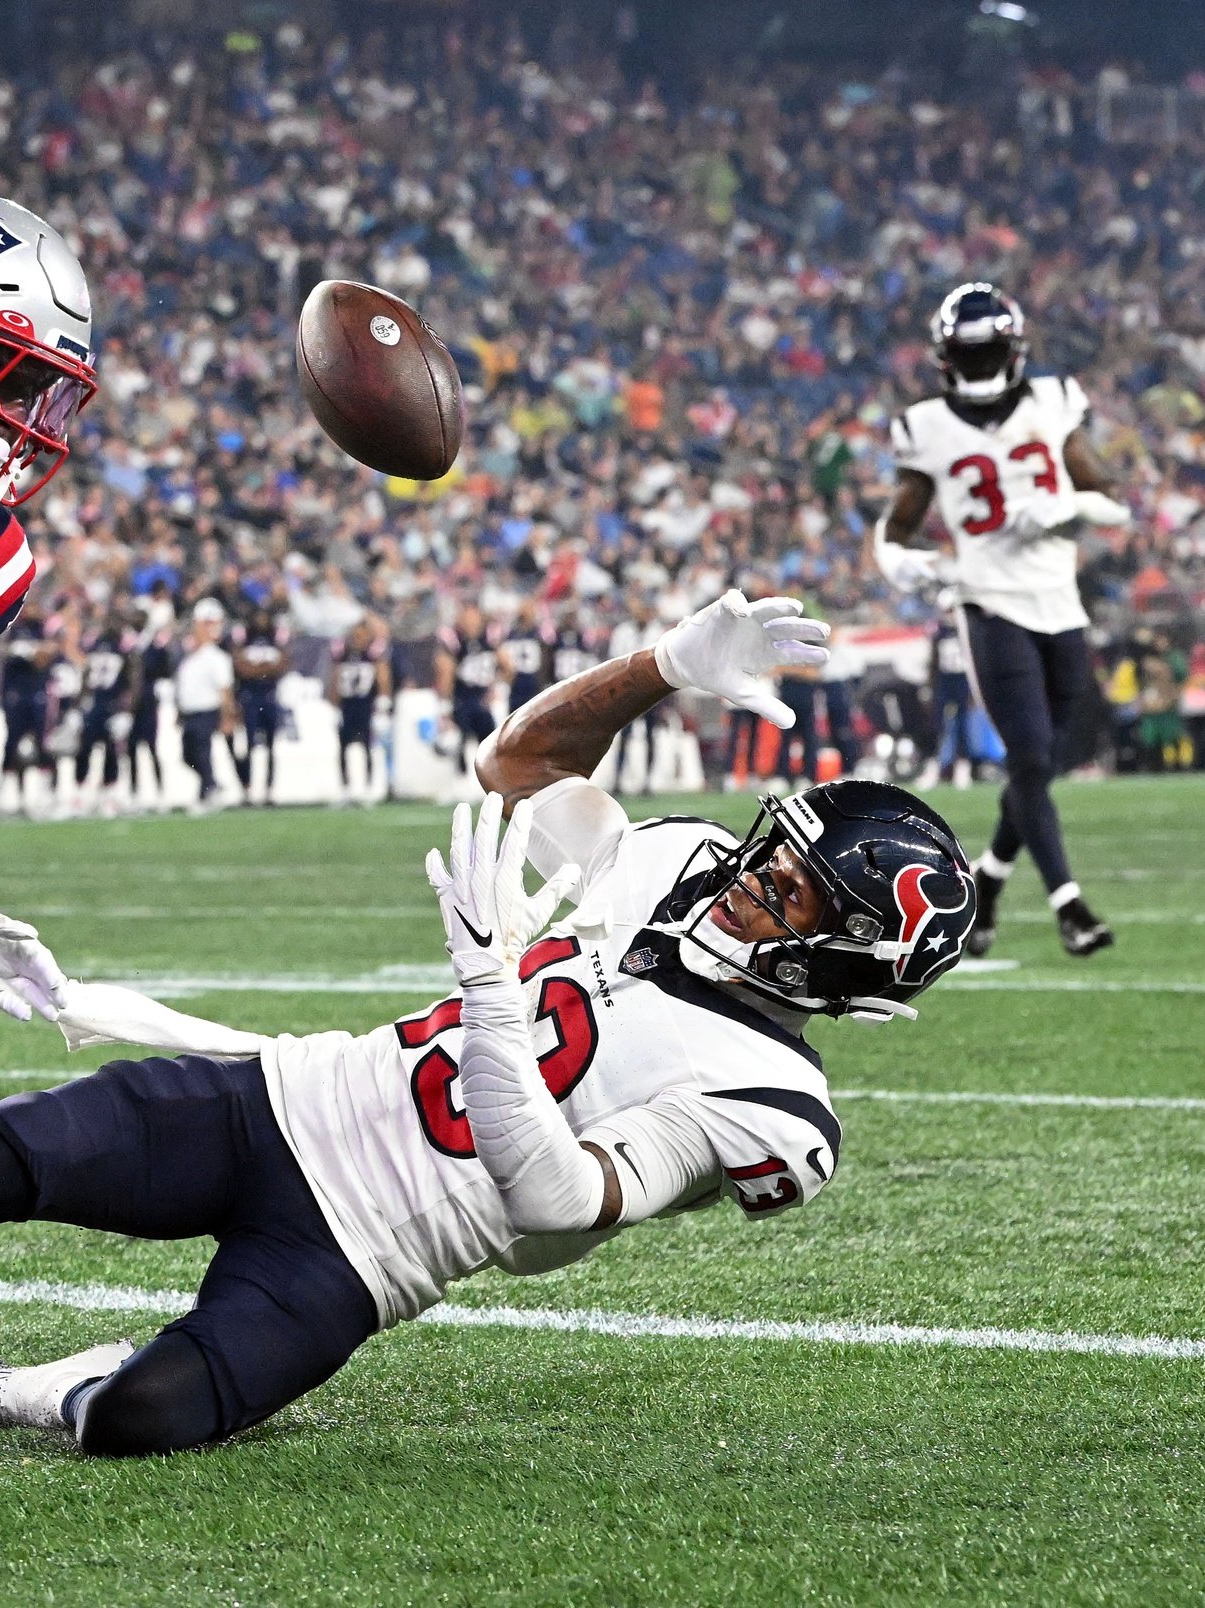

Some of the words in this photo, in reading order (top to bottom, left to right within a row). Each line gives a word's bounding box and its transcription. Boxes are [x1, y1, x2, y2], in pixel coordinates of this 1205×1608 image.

[948, 440, 1059, 536] 33
[792, 797, 815, 825] TEXANS
[590, 950, 614, 1008] TEXANS
[721, 1154, 798, 1212] 13
